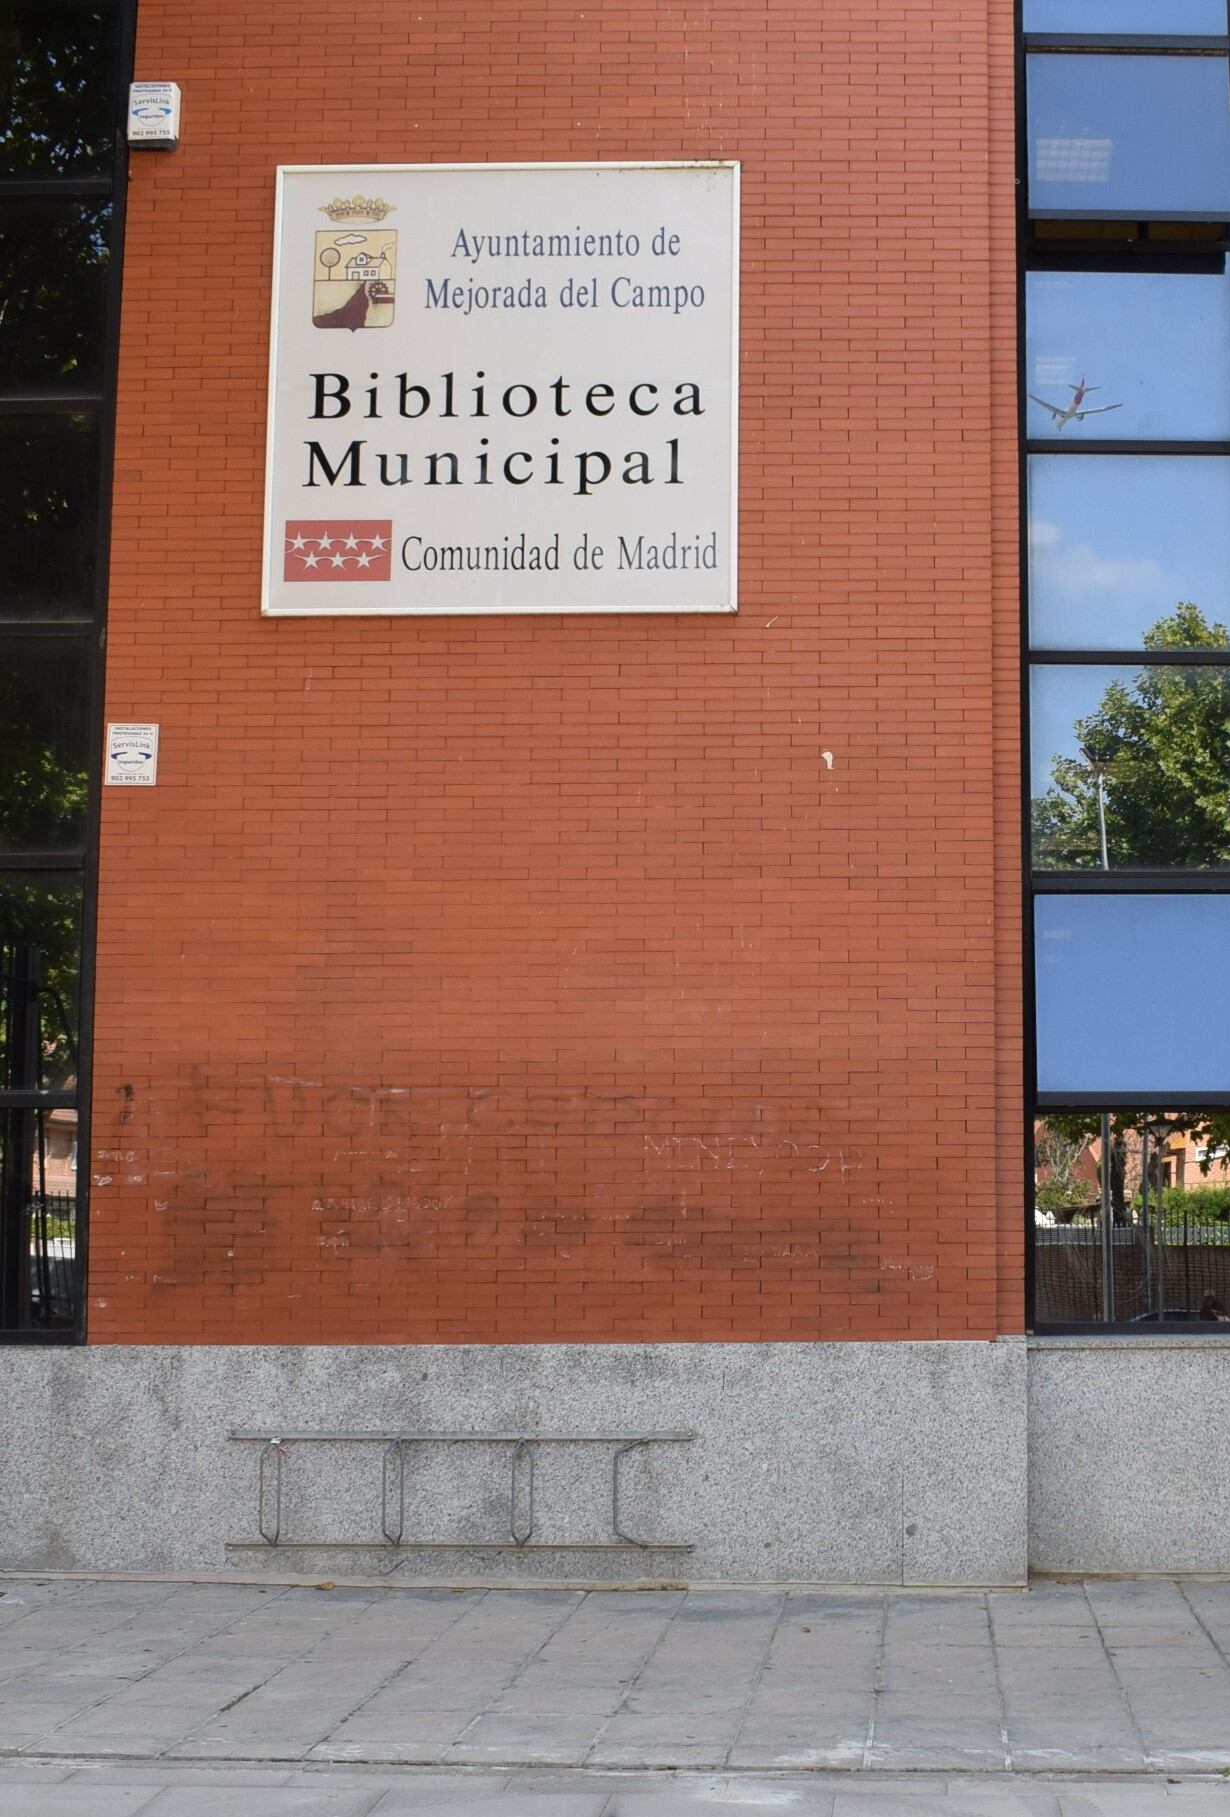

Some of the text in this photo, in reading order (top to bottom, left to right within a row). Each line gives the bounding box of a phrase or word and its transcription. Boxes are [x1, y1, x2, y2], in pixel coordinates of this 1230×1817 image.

[451, 226, 681, 264] Ayuntamiento de
[424, 277, 705, 315] Mejorada del Campo
[307, 371, 706, 420] Biblioteca
[302, 438, 685, 496] Municipal
[401, 532, 718, 571] Comunidad de Madrid
